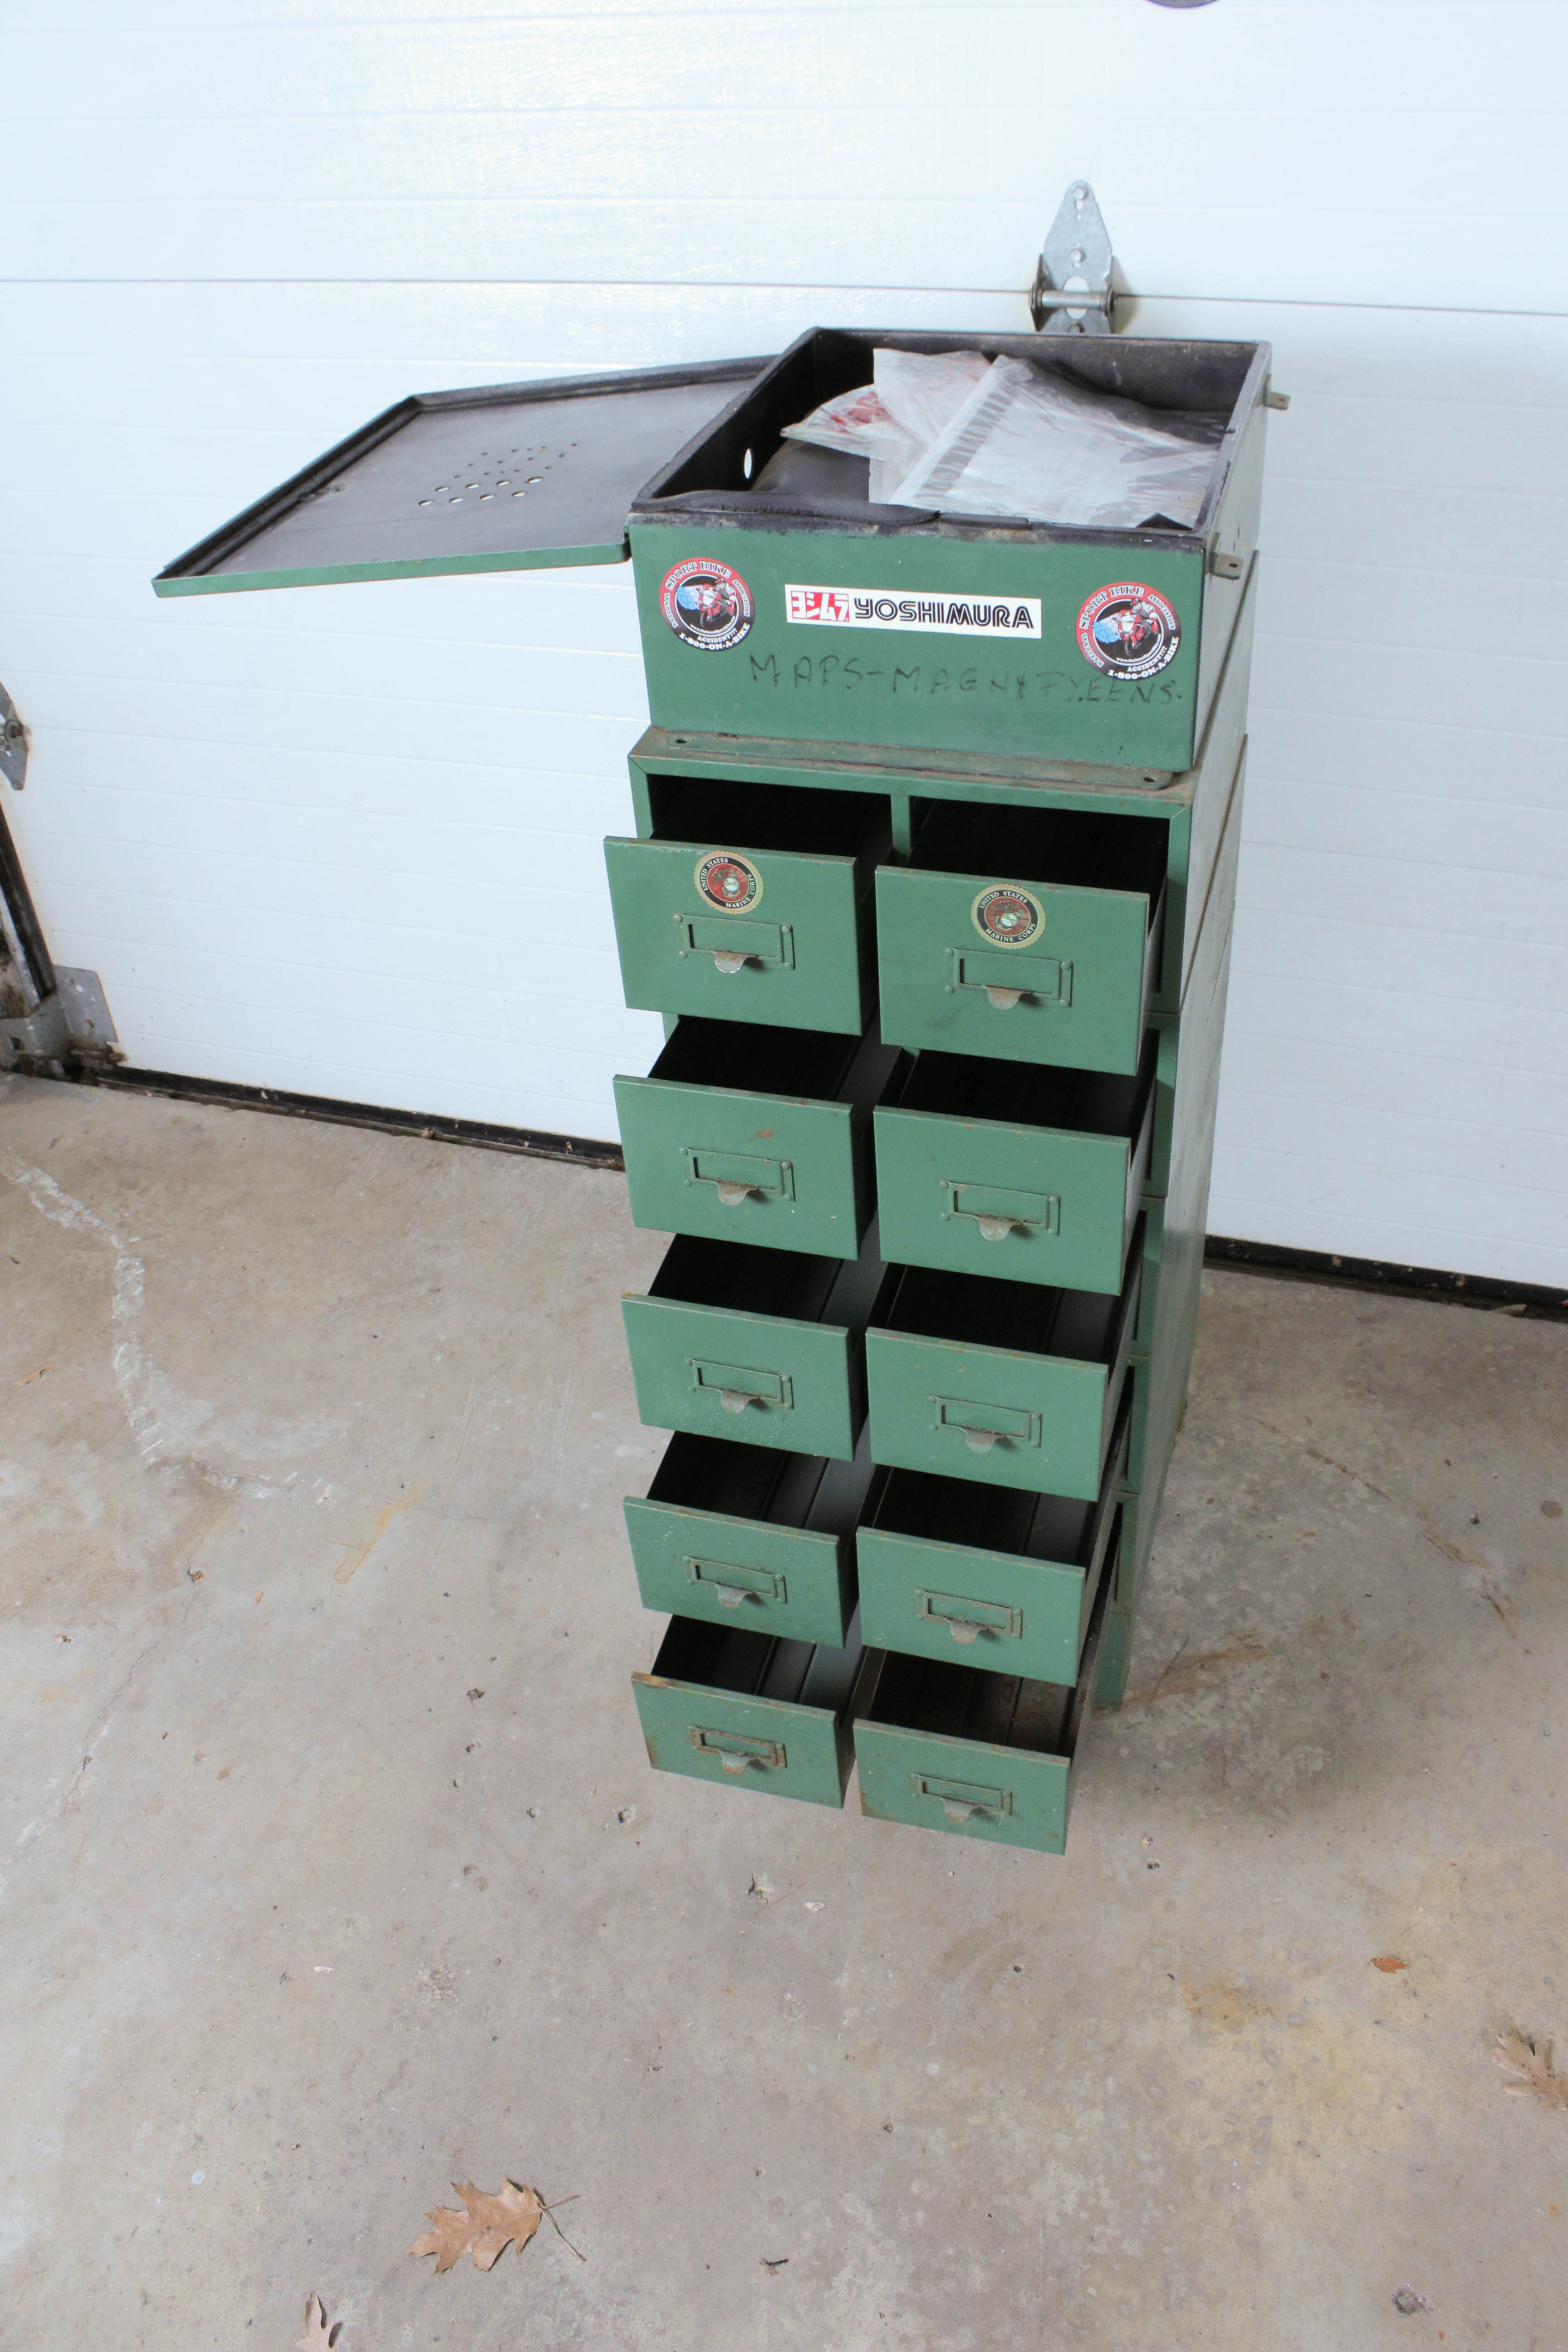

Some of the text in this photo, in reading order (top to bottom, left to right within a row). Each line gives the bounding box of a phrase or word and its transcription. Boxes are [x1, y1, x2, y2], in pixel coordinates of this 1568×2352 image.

[664, 561, 750, 628] NATIONAL SPORT BIKE ASSOCIATION
[791, 591, 849, 622] ヨシムラ
[854, 598, 1034, 628] YOSHIMURA
[1079, 585, 1176, 667] NATIONAL SPORT BIKE ASSOCIATION
[1107, 637, 1179, 679] 1-800-ON-A-BIKE
[706, 858, 728, 868] STATES
[726, 873, 755, 907] MARINE CORPS
[979, 891, 1028, 908] UNITED STATES
[985, 923, 1036, 942] MARINE CORPS
